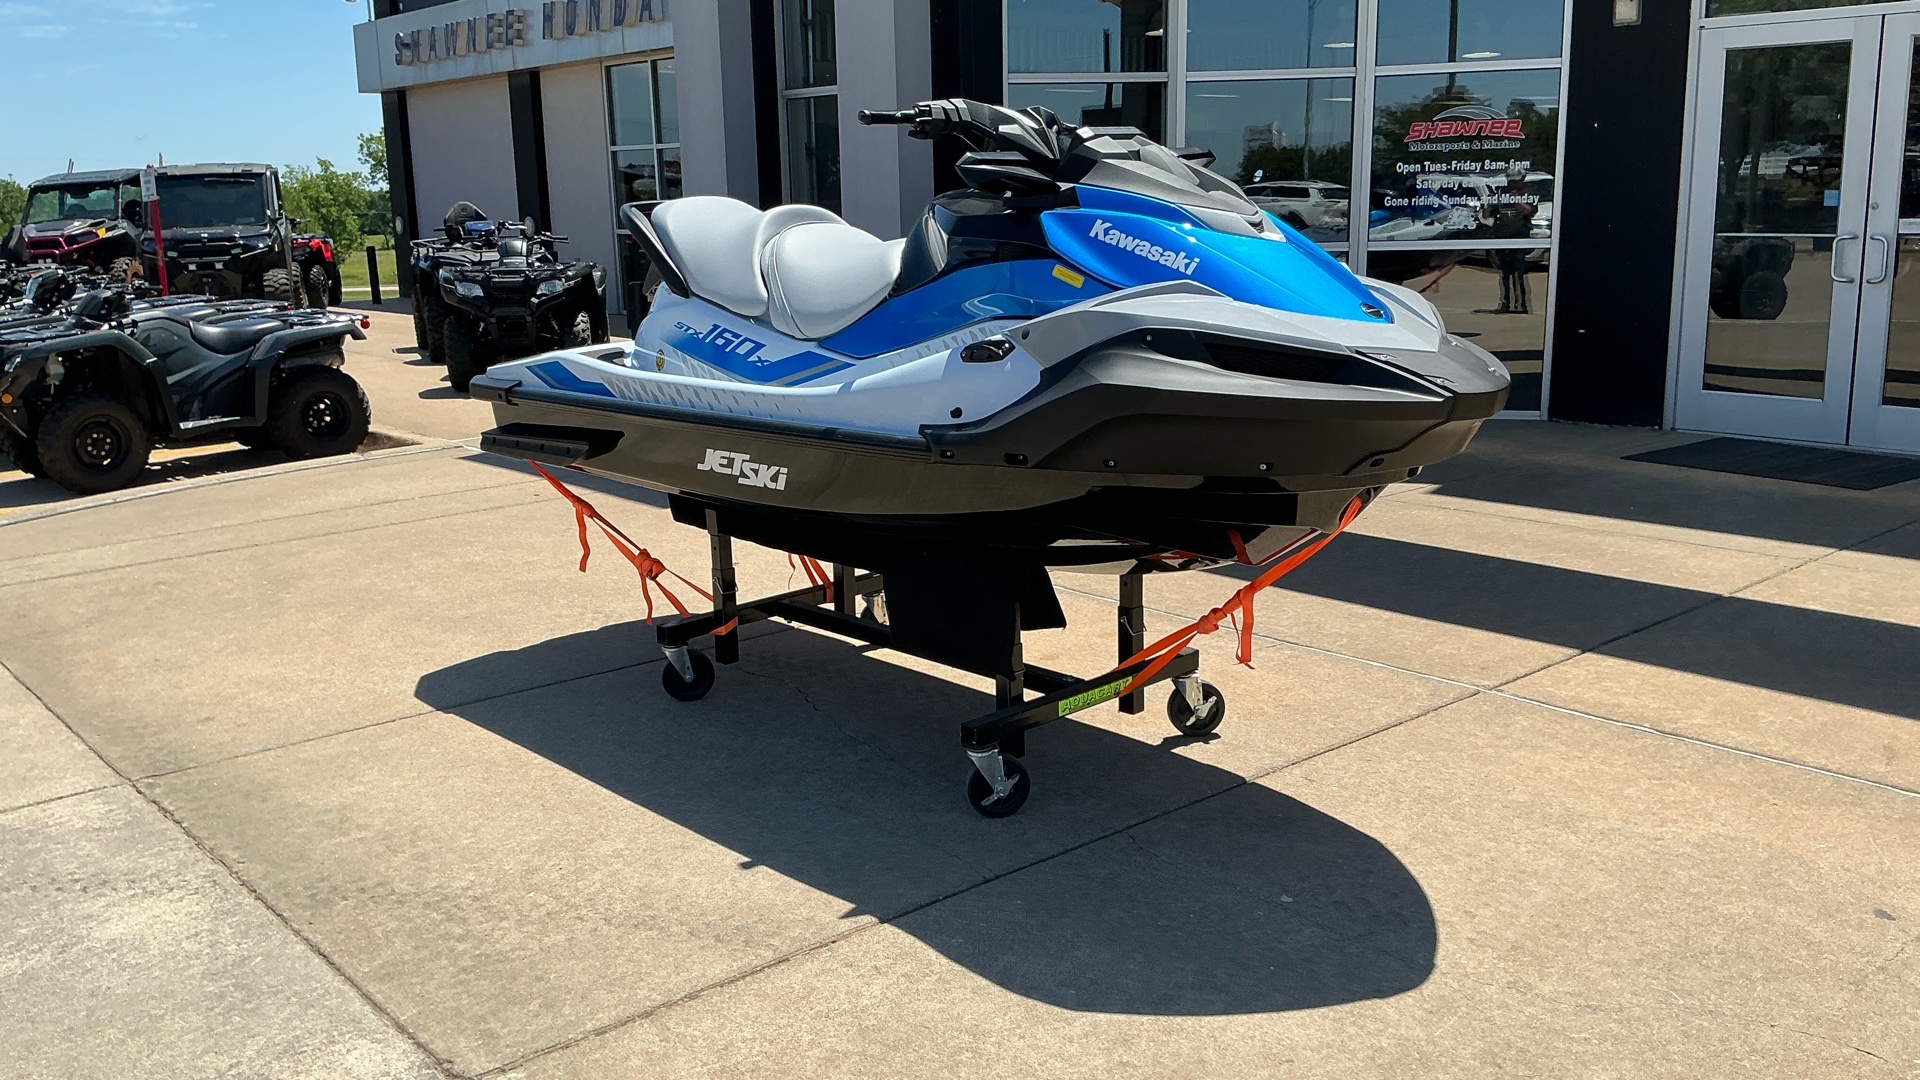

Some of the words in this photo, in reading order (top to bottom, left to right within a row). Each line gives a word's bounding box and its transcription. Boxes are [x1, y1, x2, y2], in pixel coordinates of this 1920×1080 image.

[395, 9, 527, 66] SHAWNEE
[1408, 142, 1470, 152] Motorsports
[1471, 141, 1480, 149] &
[1482, 139, 1520, 149] Marine
[1396, 162, 1421, 174] Open
[1384, 196, 1408, 206] Gone
[1411, 195, 1439, 208] riding
[1442, 194, 1477, 206] Sunday
[1480, 194, 1498, 204] and
[1501, 193, 1540, 205] Monday
[1089, 219, 1200, 276] Kawasaki
[673, 321, 705, 340] STX
[1062, 678, 1130, 713] AQUACART
